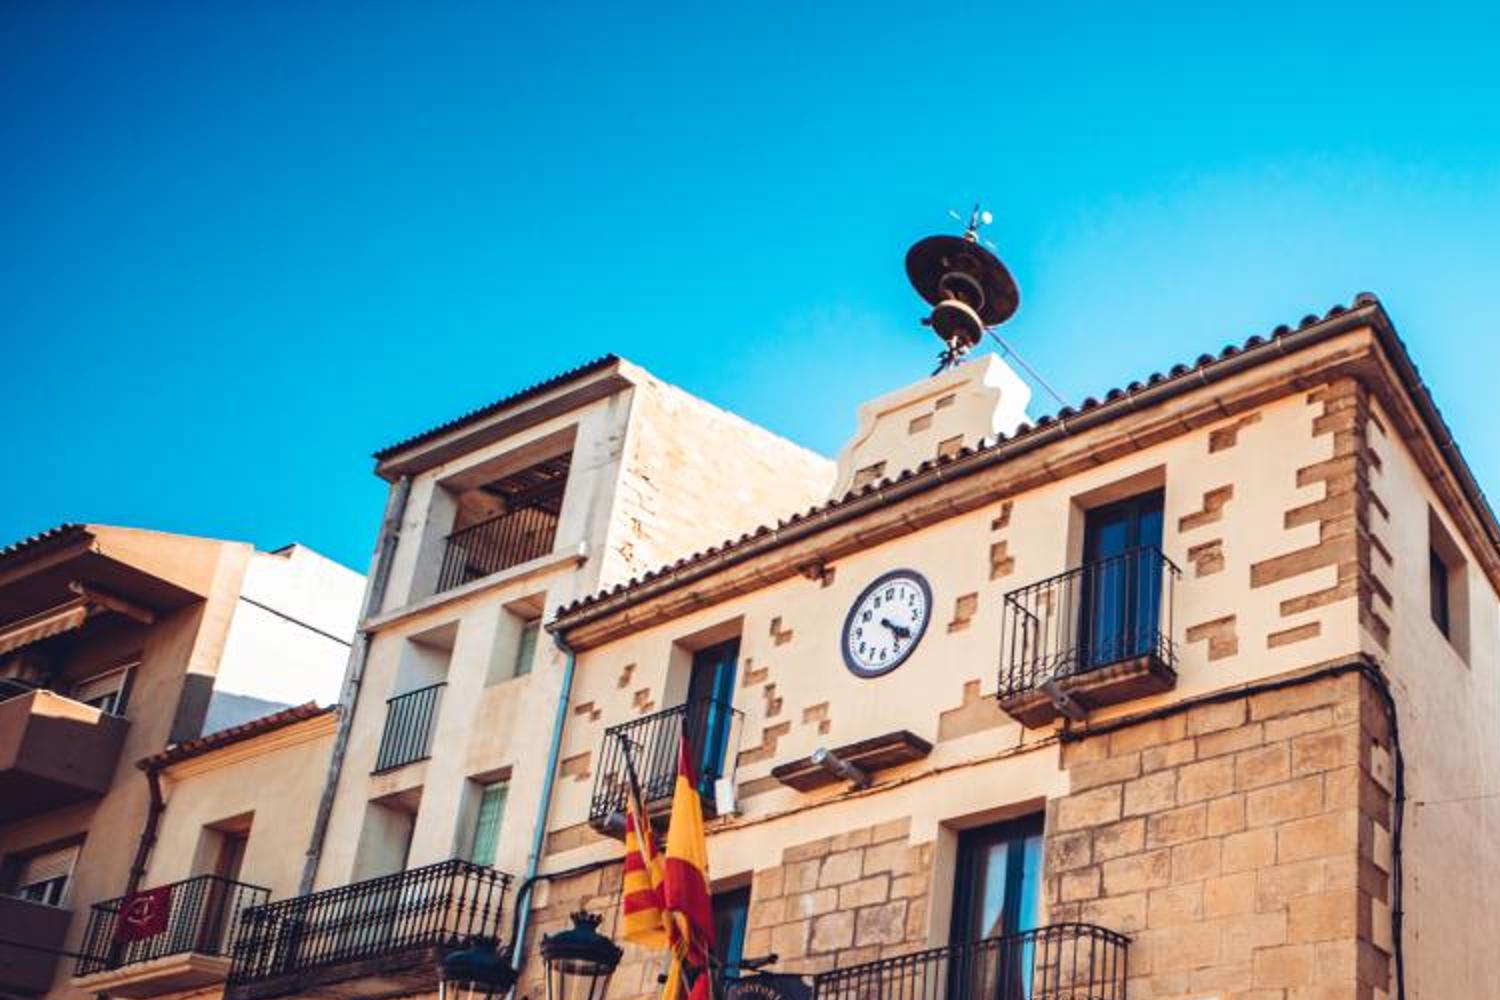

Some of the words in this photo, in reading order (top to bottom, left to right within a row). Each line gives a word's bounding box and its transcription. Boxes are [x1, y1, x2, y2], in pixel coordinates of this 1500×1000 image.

[885, 587, 895, 601] 12
[909, 594, 915, 606] 2
[911, 608, 919, 621] 3
[856, 627, 863, 639] 9
[869, 647, 876, 661] 7
[880, 648, 886, 660] 6
